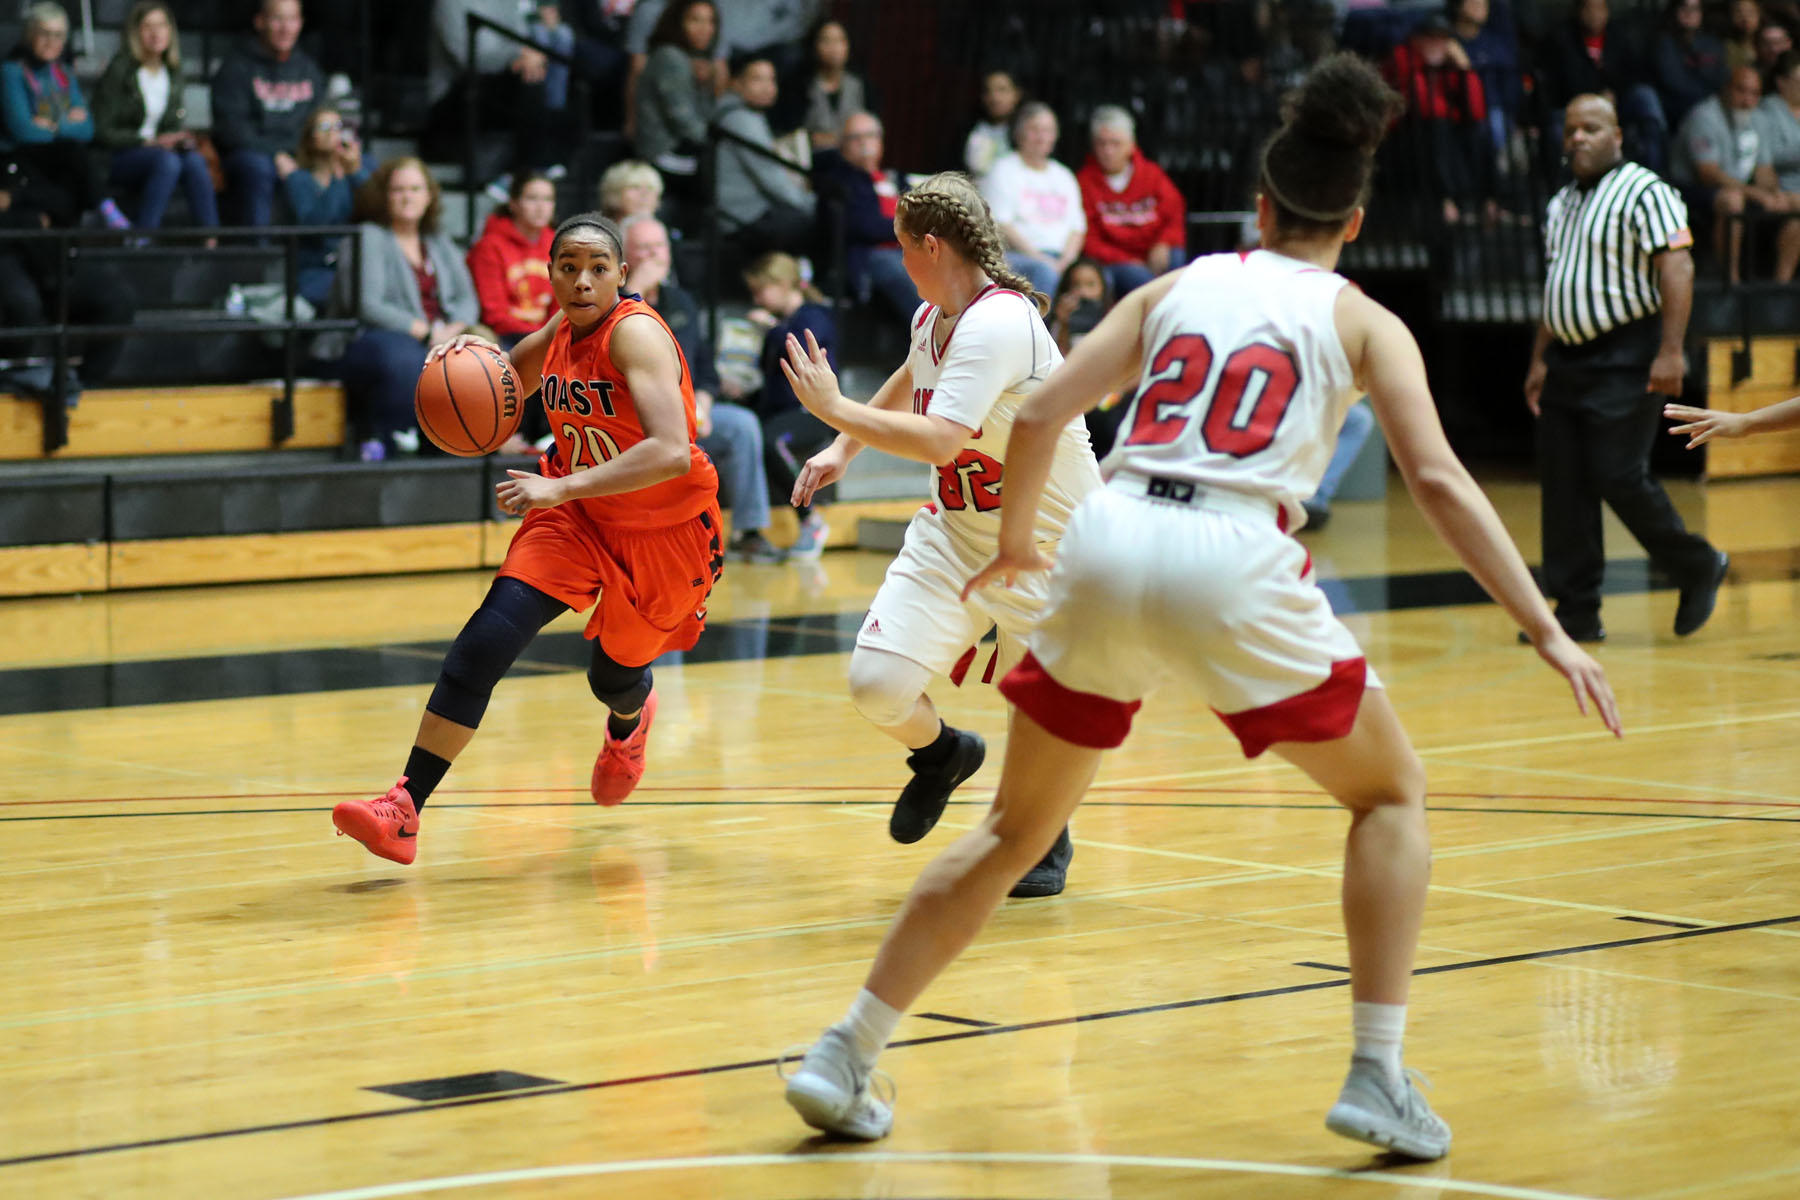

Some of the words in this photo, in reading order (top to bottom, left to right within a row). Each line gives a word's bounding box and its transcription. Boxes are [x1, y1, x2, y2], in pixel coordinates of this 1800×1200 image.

[541, 373, 616, 417] OAST
[1123, 333, 1303, 460] 20
[561, 422, 622, 475] 20
